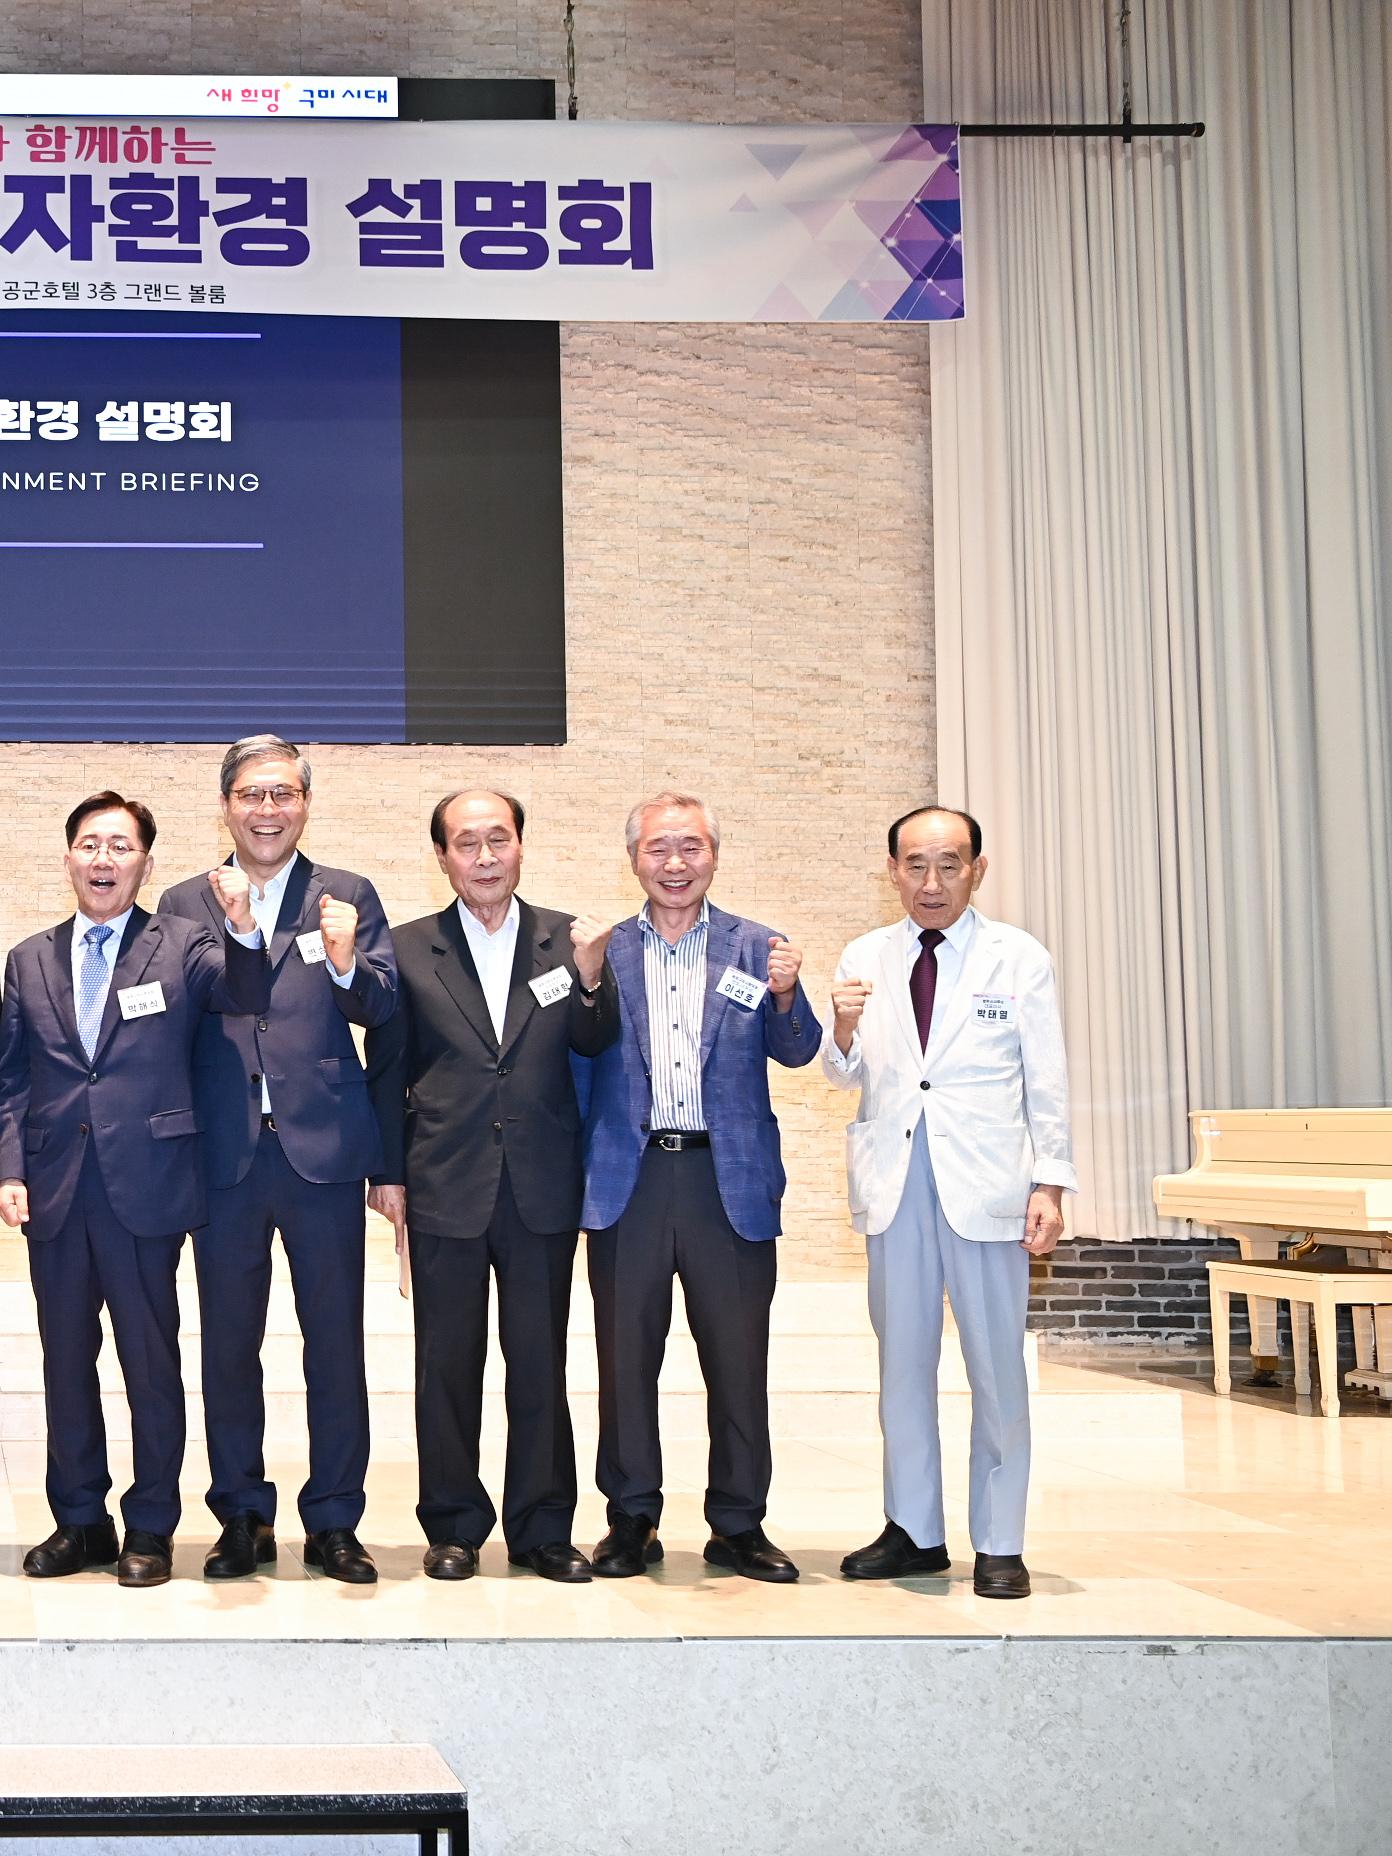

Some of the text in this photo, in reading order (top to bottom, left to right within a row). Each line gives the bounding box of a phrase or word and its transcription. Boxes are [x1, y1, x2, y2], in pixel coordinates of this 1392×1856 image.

[206, 88, 388, 113] 새 희망 구미 시대
[25, 122, 216, 166] 함께하는
[344, 178, 655, 271] 설명회
[1, 281, 80, 301] 공군호텔
[86, 281, 118, 302] 3층
[123, 283, 183, 303] 그랜드
[188, 283, 227, 305] 볼룸
[95, 400, 232, 442] 설명회
[121, 472, 260, 492] BRIEFING
